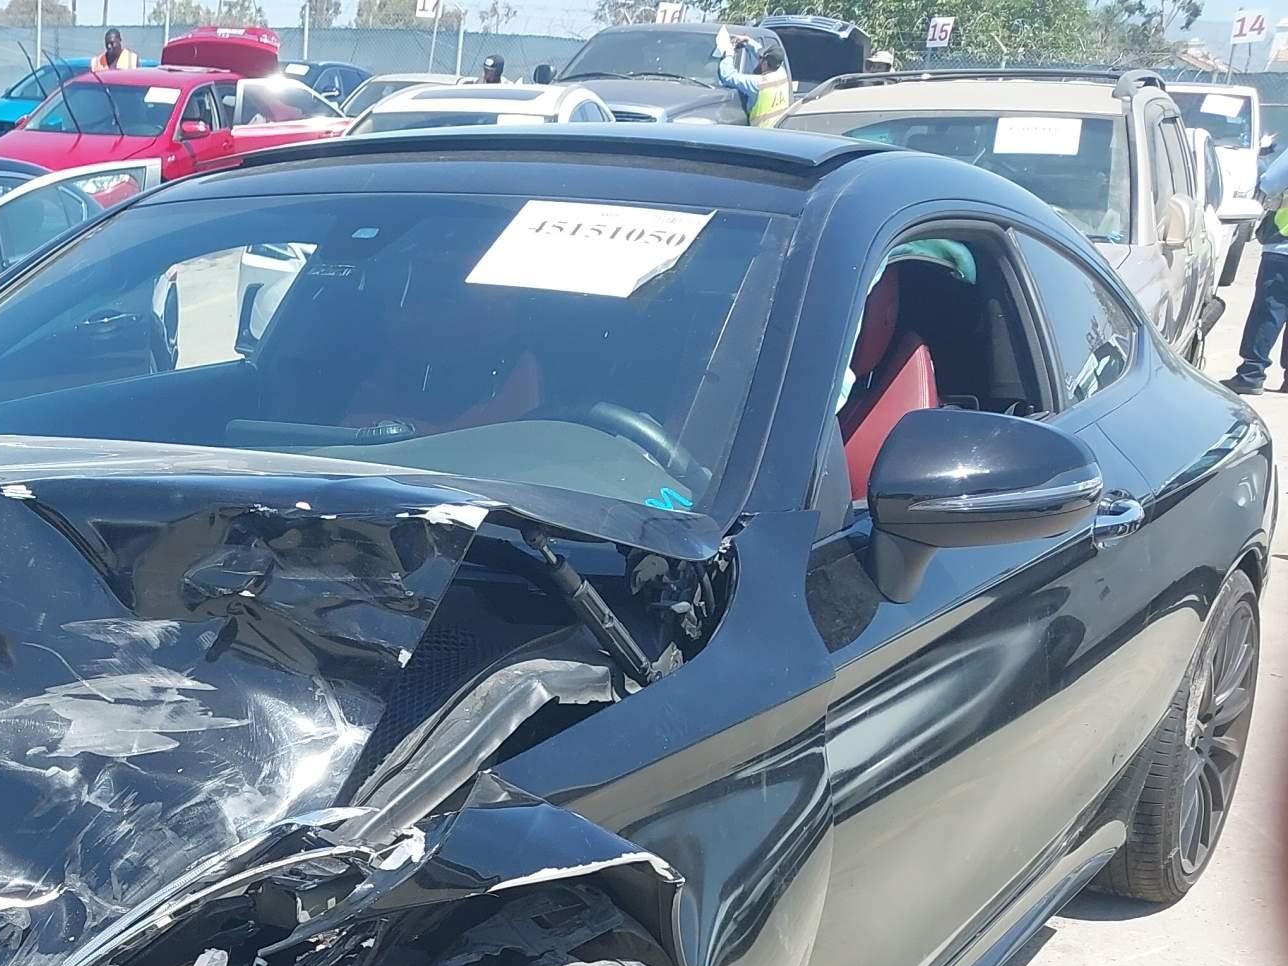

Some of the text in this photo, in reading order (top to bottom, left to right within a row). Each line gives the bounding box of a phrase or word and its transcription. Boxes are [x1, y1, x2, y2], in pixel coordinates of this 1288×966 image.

[928, 23, 951, 42] 15
[1233, 14, 1265, 38] 14
[528, 220, 687, 248] 45151050
